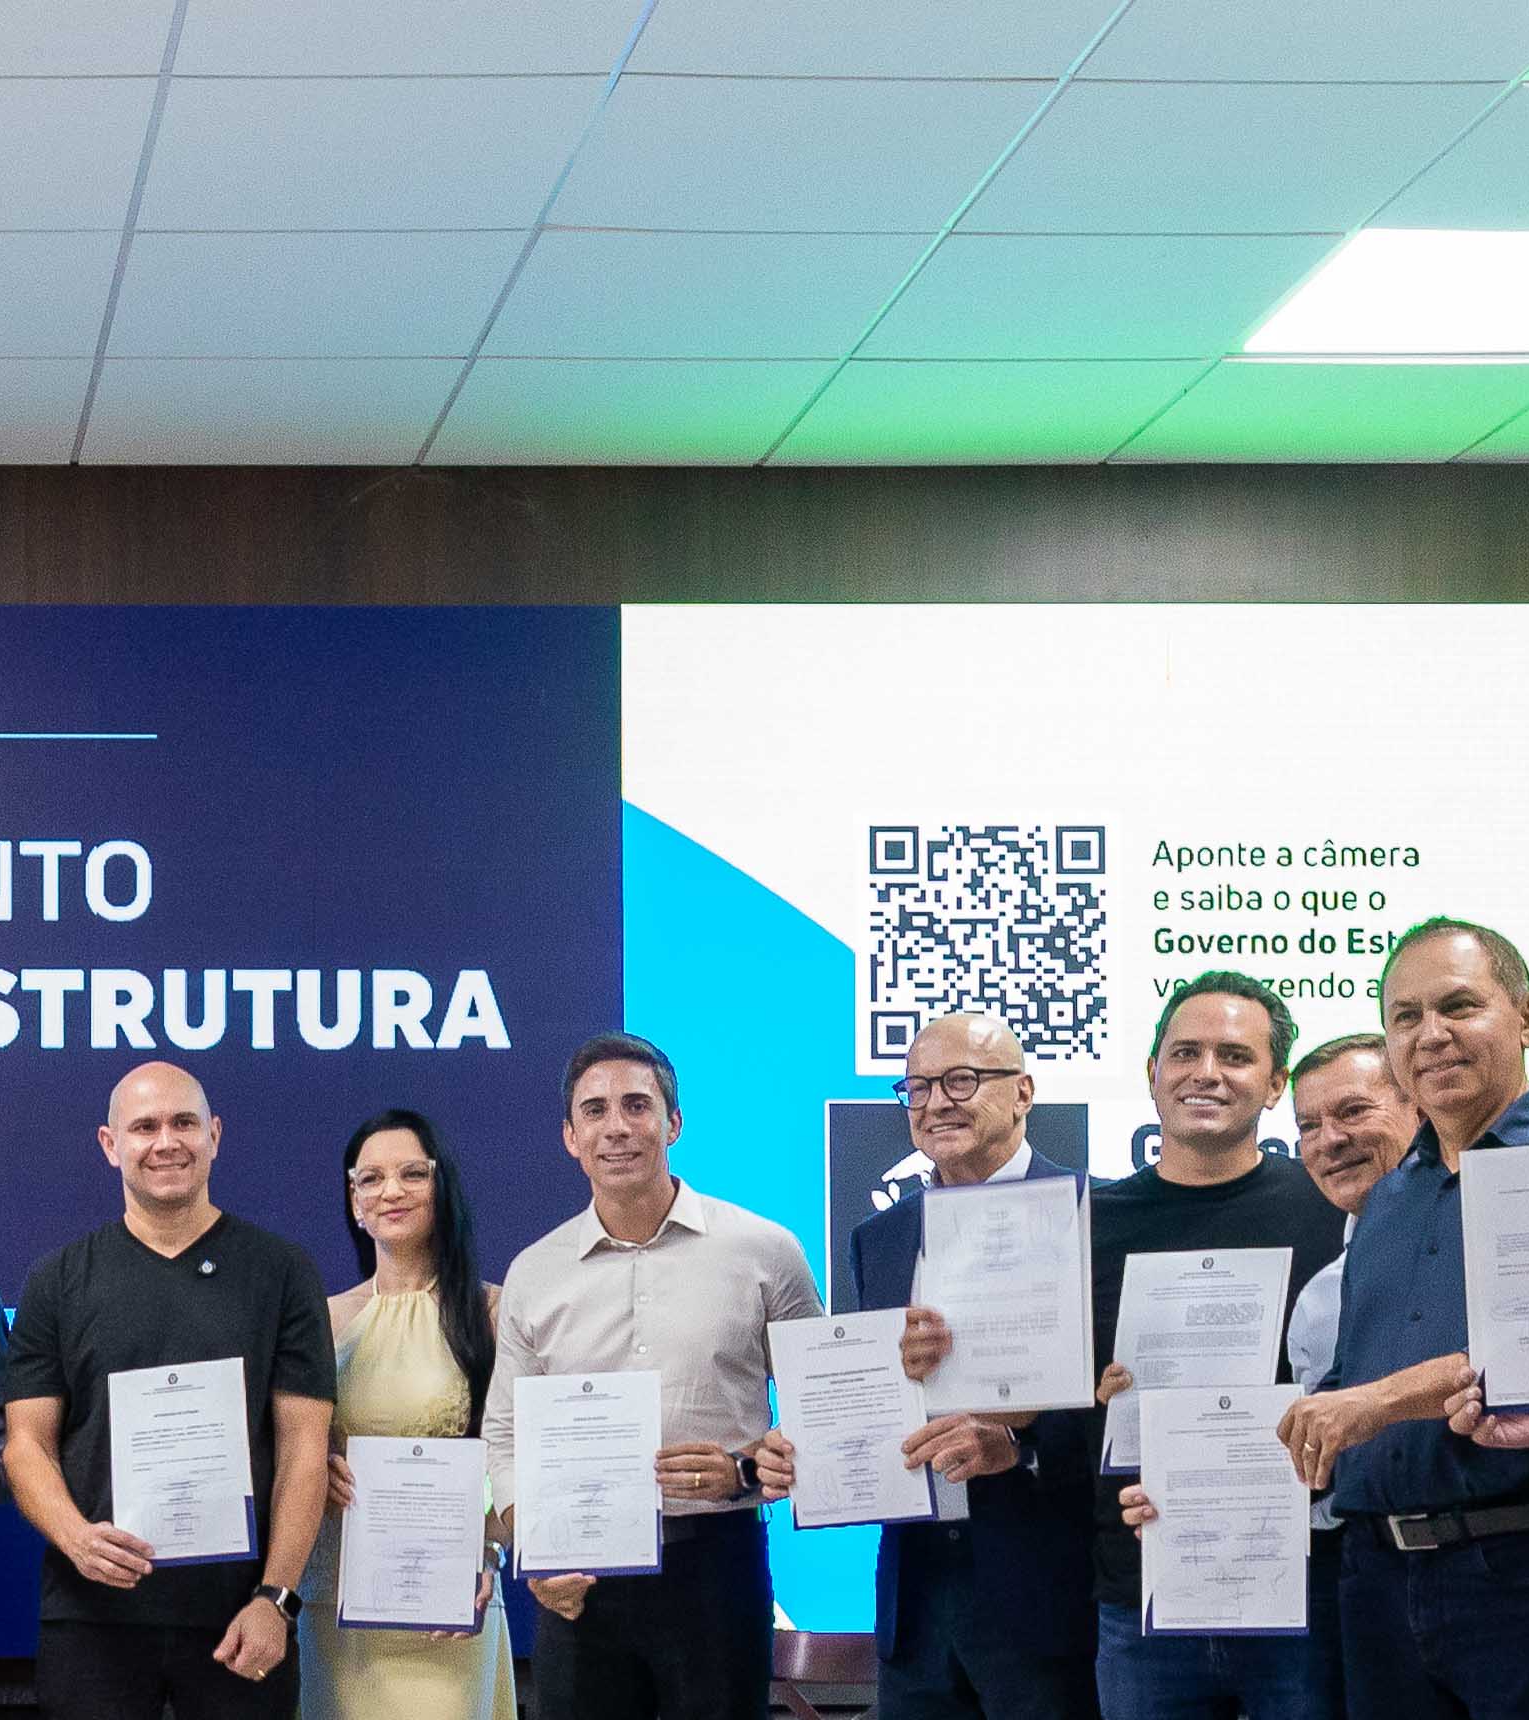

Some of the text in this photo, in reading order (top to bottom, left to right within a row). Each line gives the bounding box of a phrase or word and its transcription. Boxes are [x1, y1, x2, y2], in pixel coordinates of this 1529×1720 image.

[1152, 839, 1421, 873] Aponte a câmera
[1153, 885, 1387, 917] e saiba o que o
[1154, 928, 1397, 955] Governo do Est
